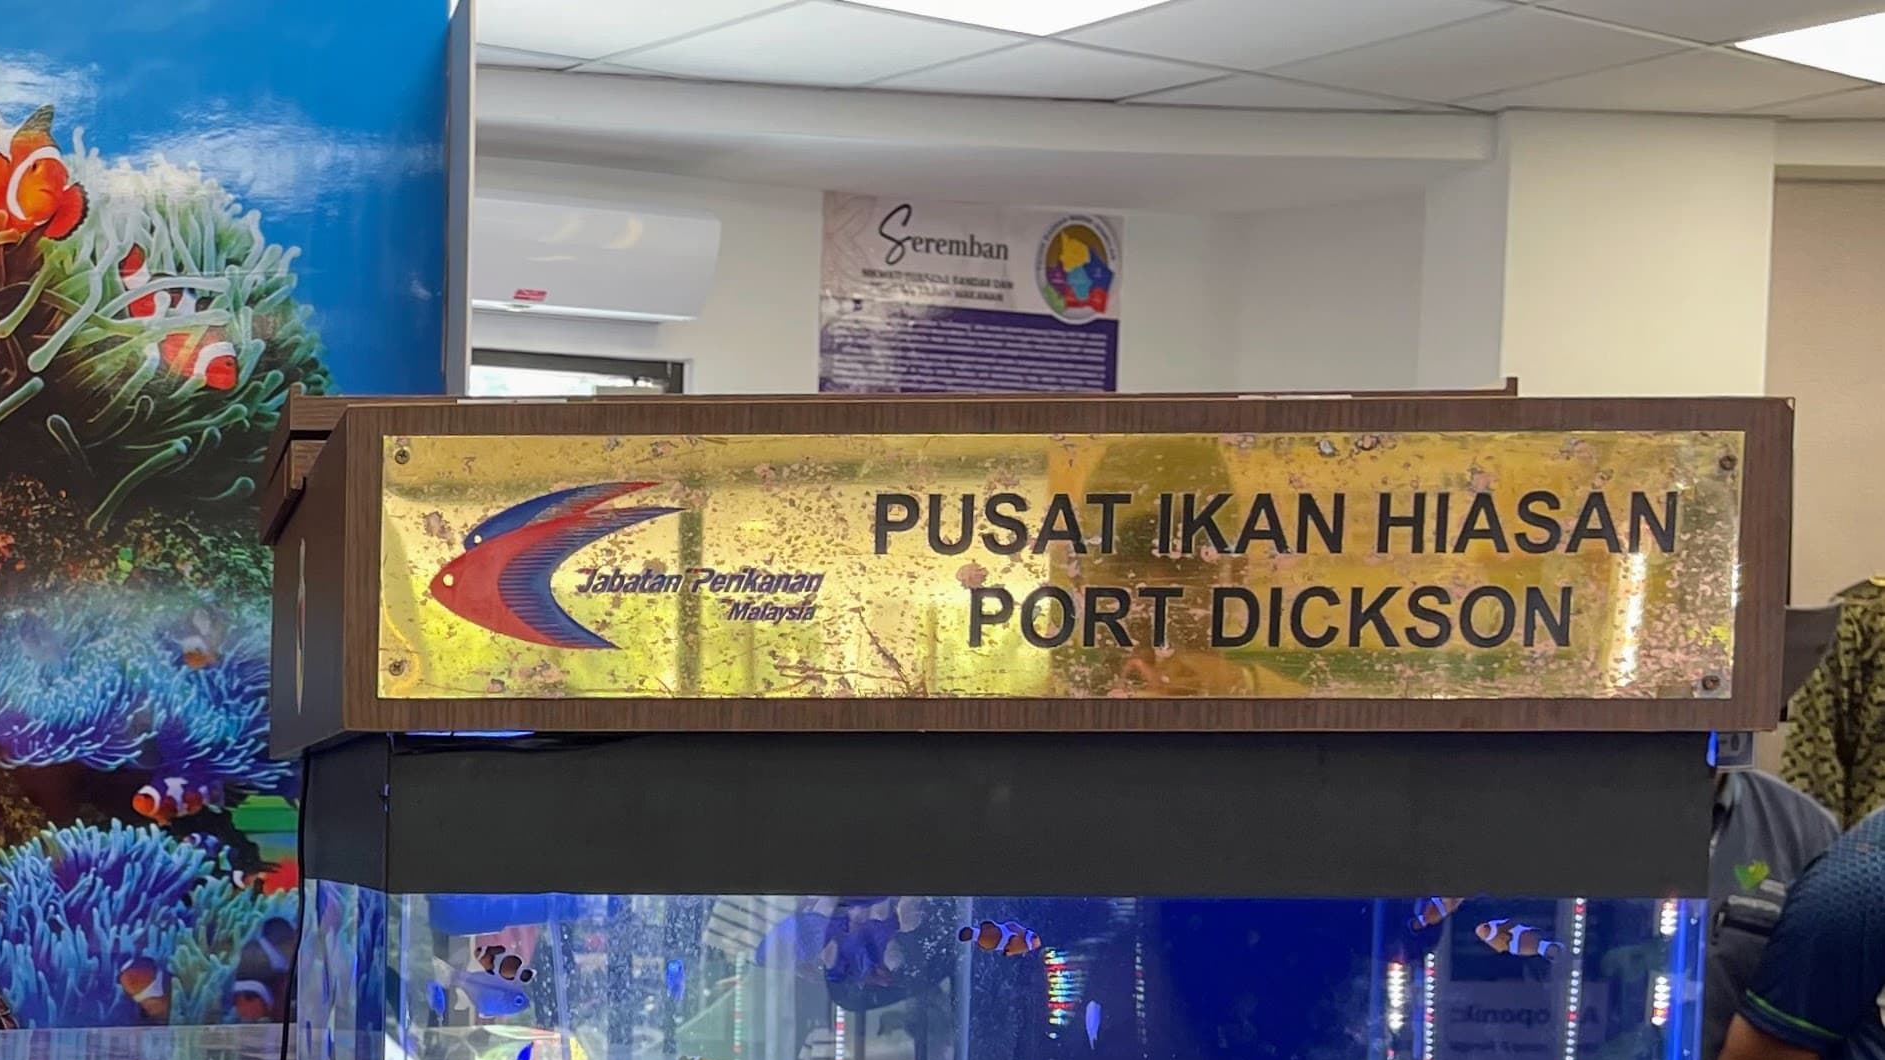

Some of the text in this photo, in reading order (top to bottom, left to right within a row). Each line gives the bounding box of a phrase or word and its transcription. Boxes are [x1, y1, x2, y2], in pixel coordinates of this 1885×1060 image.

[878, 203, 1010, 265] Seremban
[874, 489, 1680, 556] PUSAT IKAN HIASAN
[577, 566, 826, 594] Jabatan Perikanan
[726, 599, 818, 625] Malaysia
[968, 584, 1574, 649] PORT DICKSON
